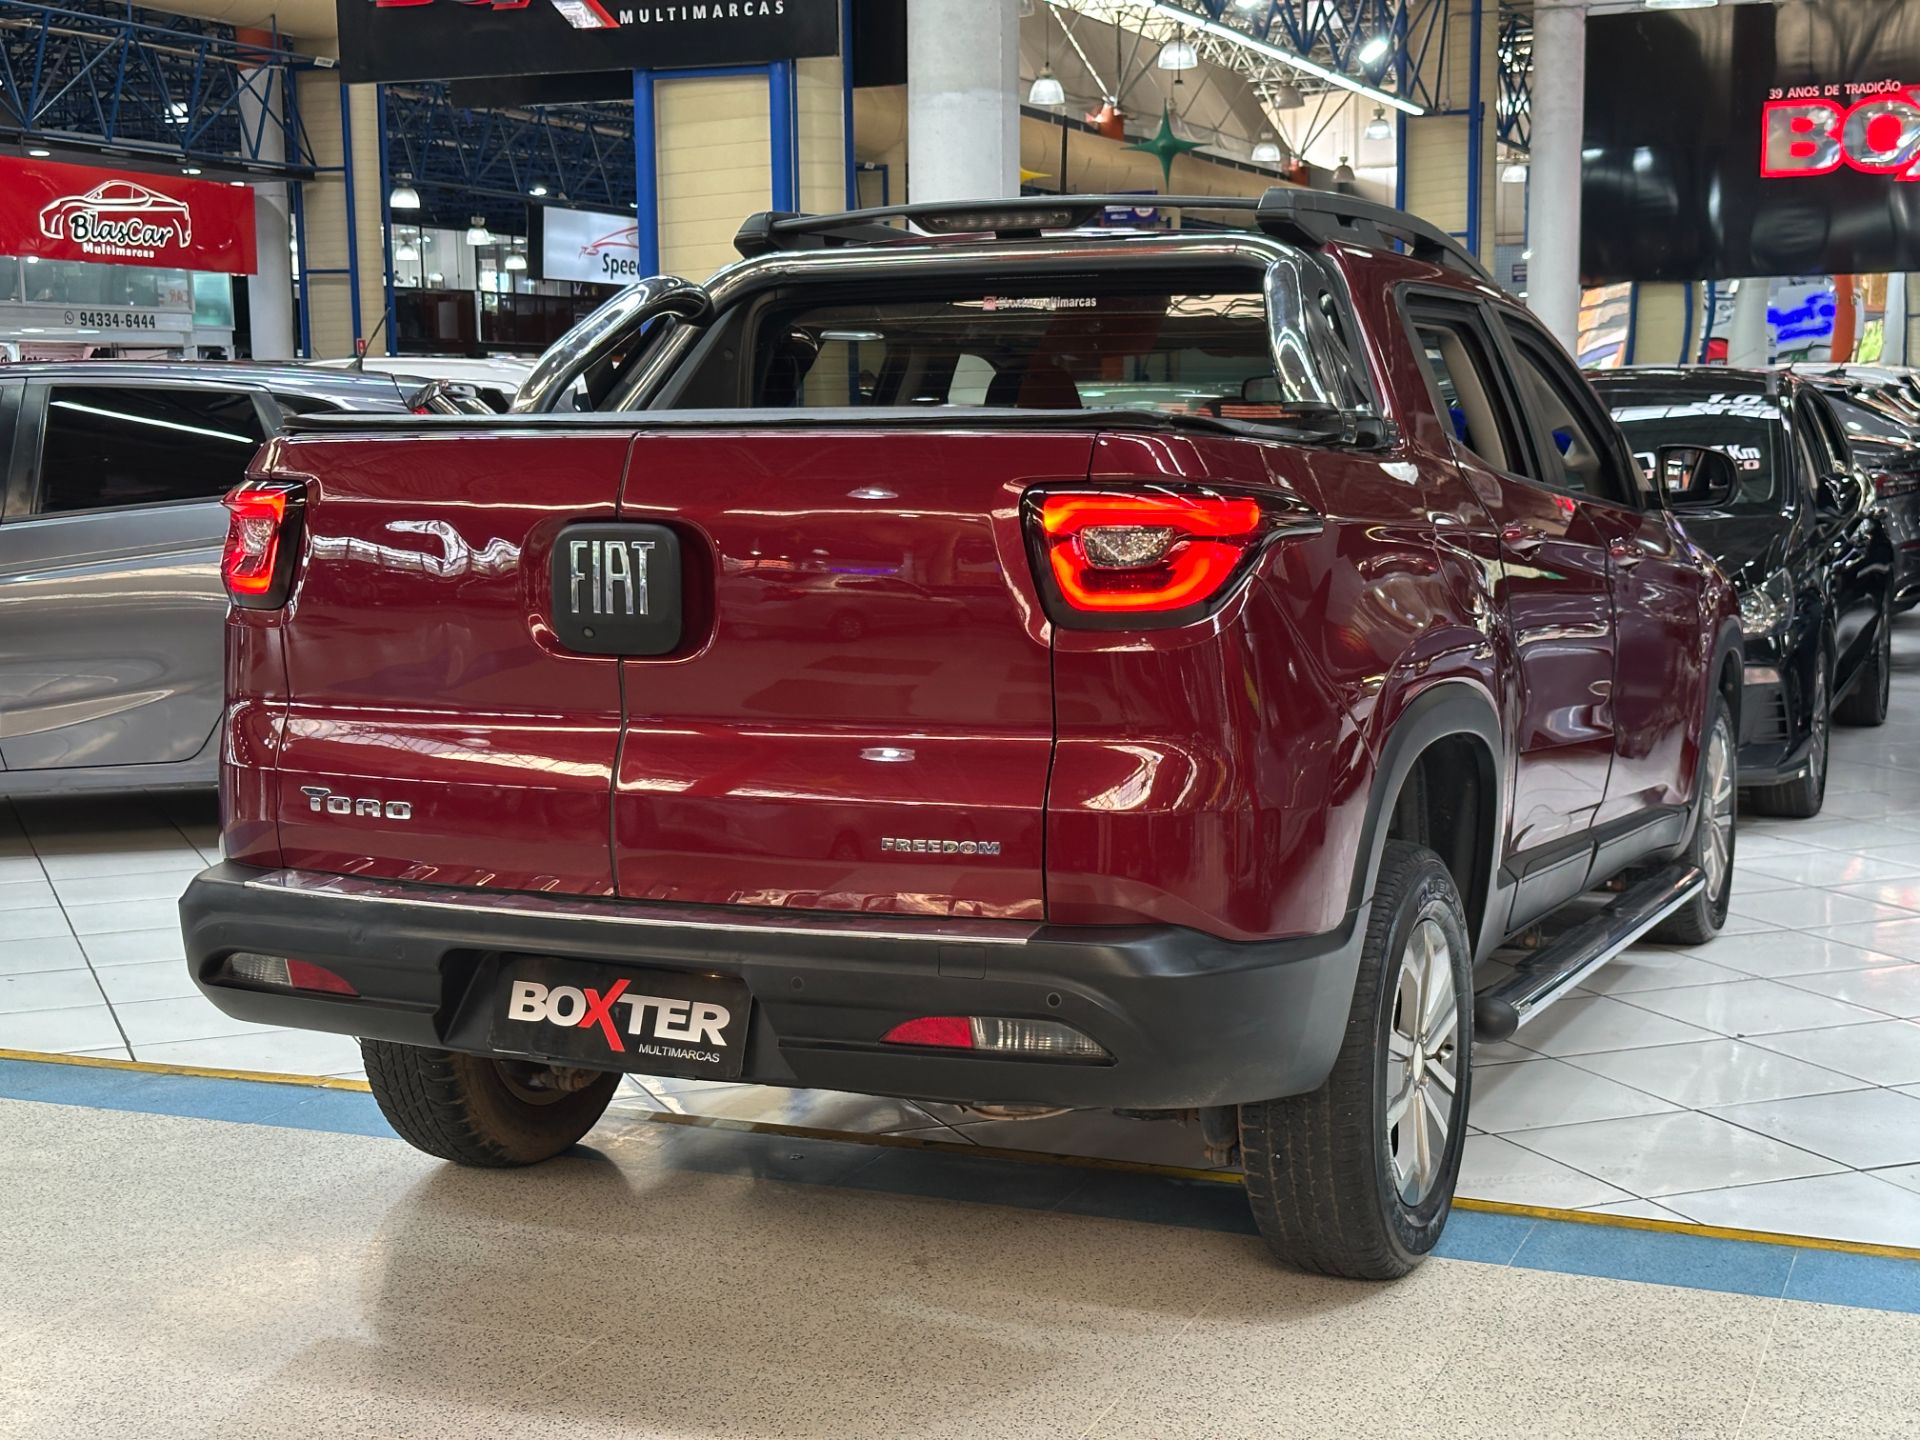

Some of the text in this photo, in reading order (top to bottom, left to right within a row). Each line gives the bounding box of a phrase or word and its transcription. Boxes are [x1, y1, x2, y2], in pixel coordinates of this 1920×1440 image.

[619, 0, 785, 24] MULTIMARCAS
[1769, 79, 1901, 99] 39 ANOS DE TRADIÇÃO
[1760, 84, 1920, 181] BO
[69, 211, 174, 248] BlasCar
[82, 243, 155, 258] Multimarcas
[602, 253, 640, 279] Spee
[80, 312, 156, 328] 94334-6444
[570, 540, 655, 615] FIAT
[881, 837, 1000, 855] FREEDOM
[508, 979, 731, 1053] BOXTER
[638, 1043, 720, 1063] MULTIMARCAS
